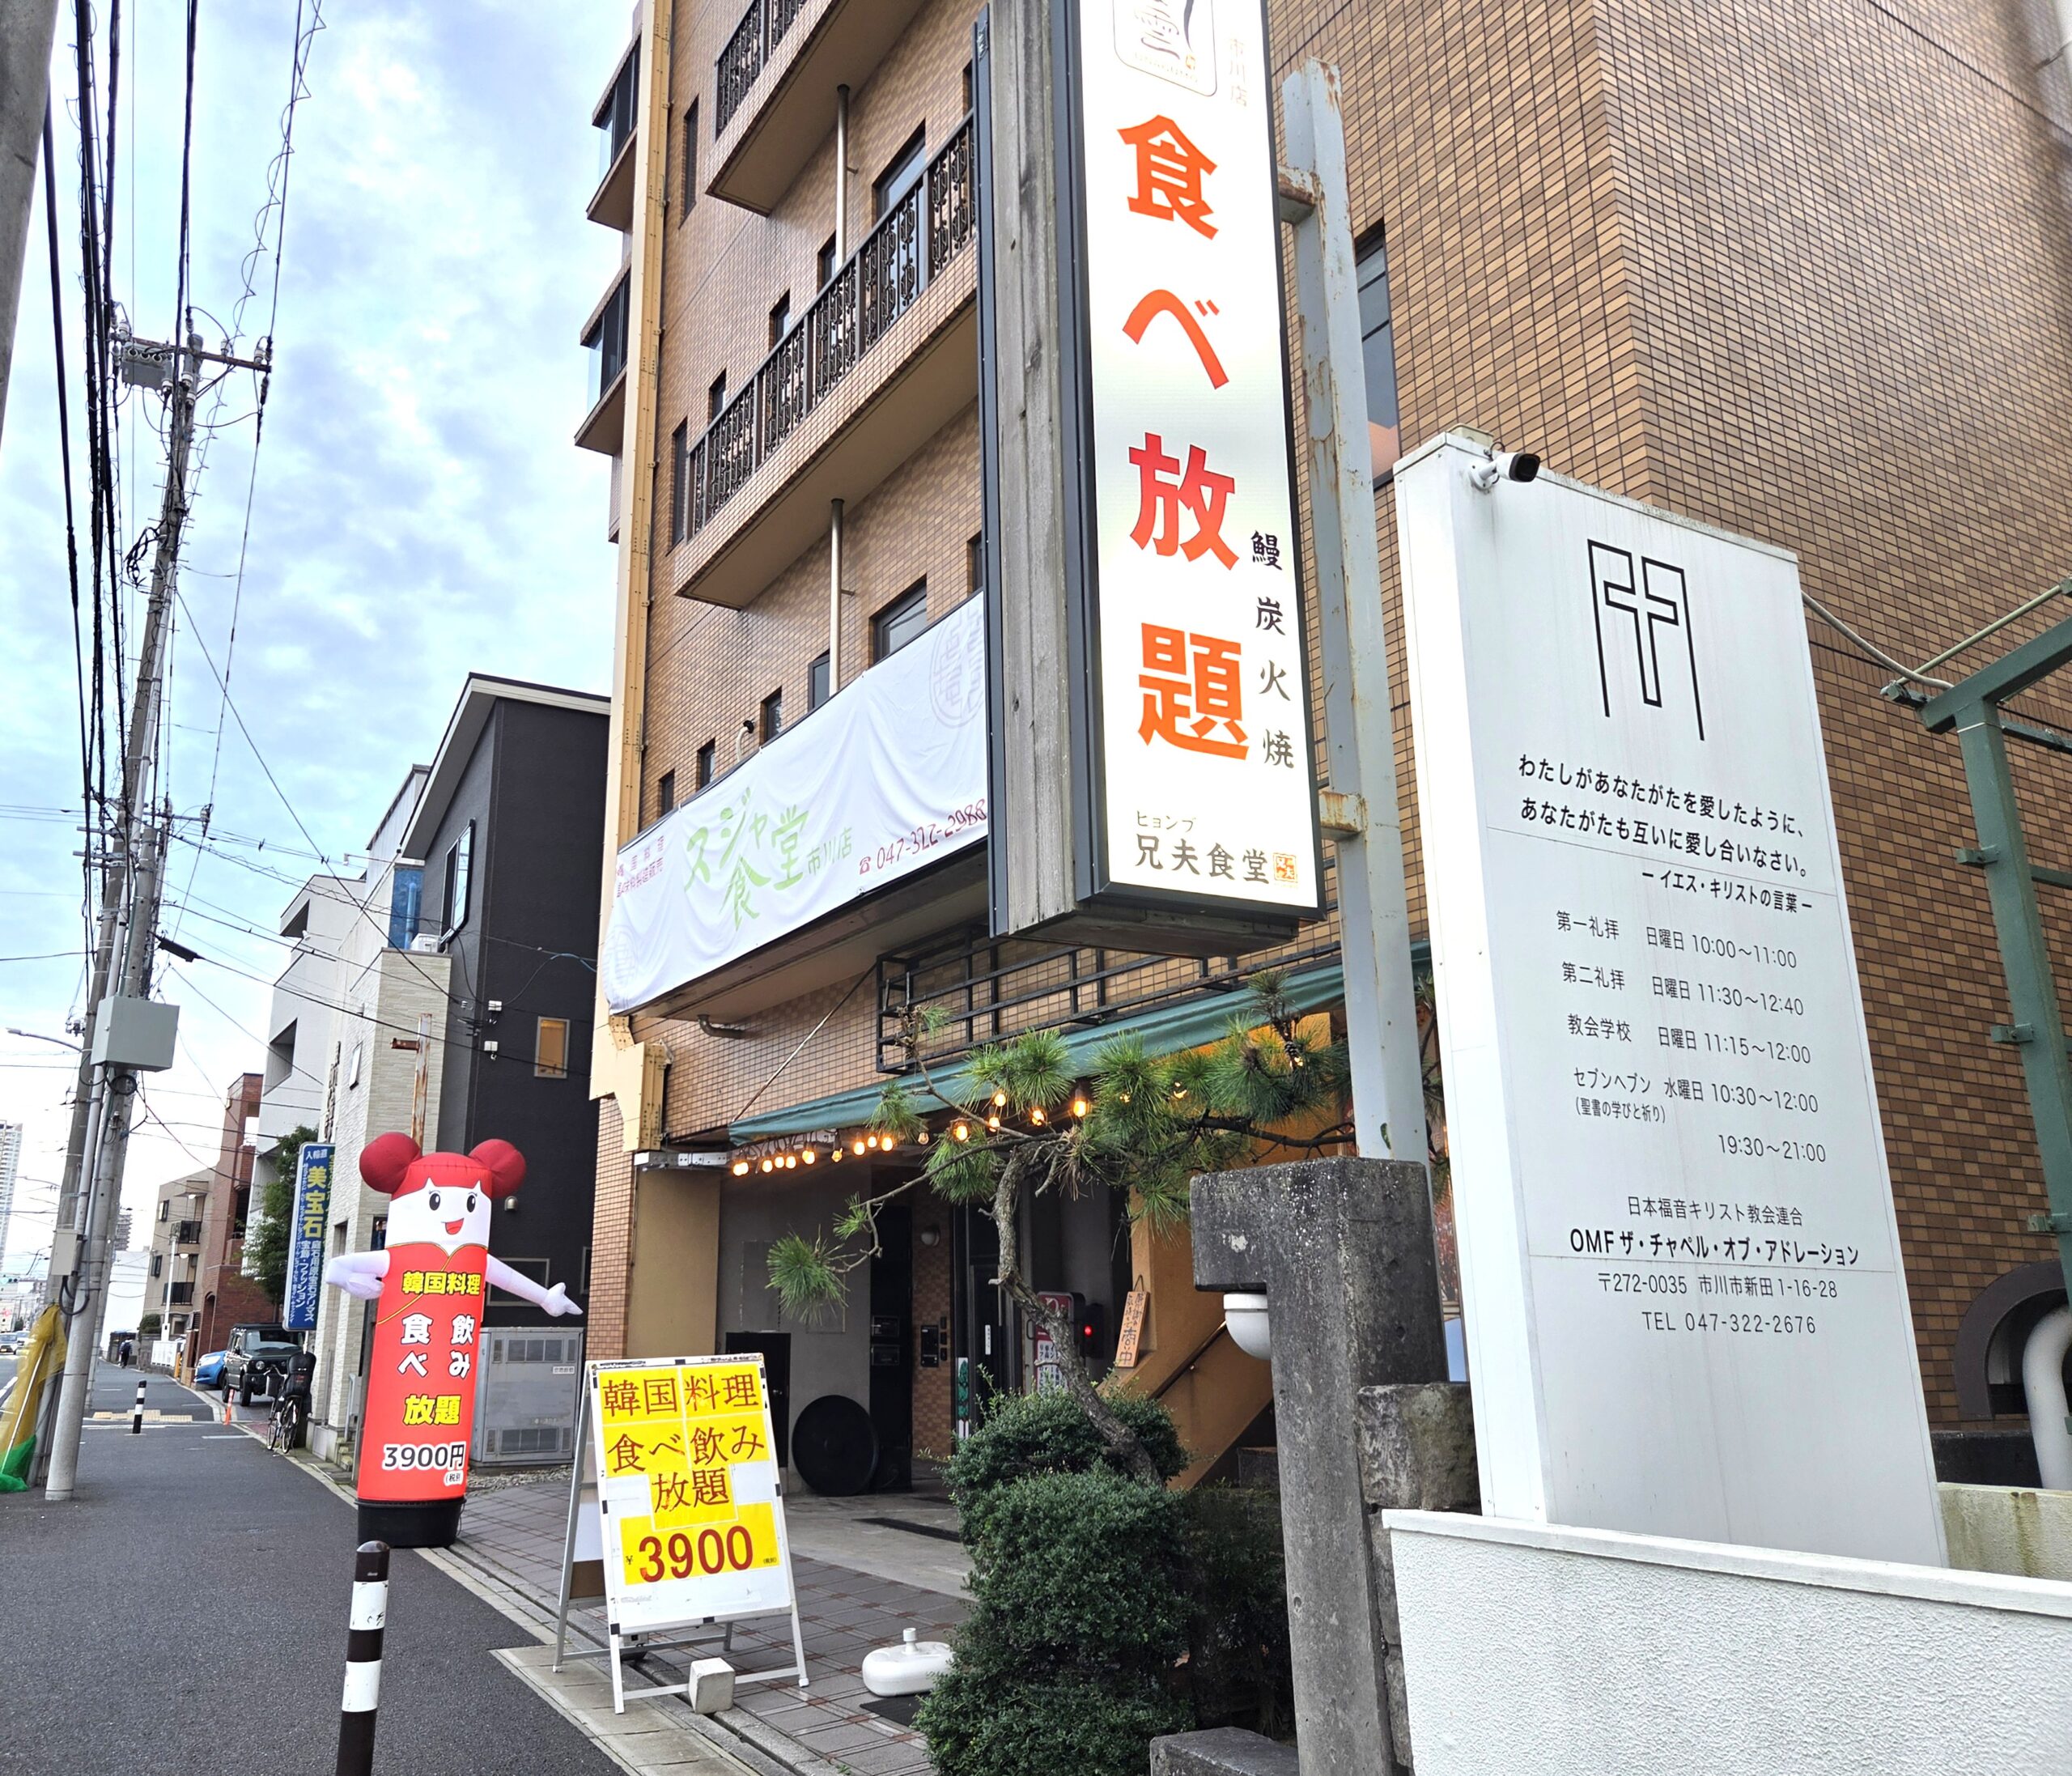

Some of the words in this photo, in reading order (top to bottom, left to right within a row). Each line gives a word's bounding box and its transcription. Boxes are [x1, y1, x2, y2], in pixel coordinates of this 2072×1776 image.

[1117, 114, 1249, 761] 食べ放題
[1250, 529, 1295, 770] 鰻炭火焼
[1518, 754, 1804, 838] わたしがあなたがたを愛したように、
[807, 827, 852, 876] 市川店
[1136, 834, 1270, 884] 兄夫食堂
[1521, 797, 1807, 877] あなたがたも互いに愛し合いなさい。
[1556, 911, 1620, 940] 第一礼拝
[1646, 927, 1684, 952] 日曜日
[1562, 962, 1624, 990] 第二礼拝
[1652, 977, 1690, 1001] 日曜日
[1567, 1013, 1632, 1043] 教会学校
[1658, 1027, 1697, 1050] 日曜日
[1573, 1068, 1651, 1094] セブンヘブン
[1664, 1077, 1704, 1103] 水曜日
[1628, 1196, 1803, 1227] 日本福音キリスト教会連合
[401, 1270, 482, 1295] 韓国料理
[1642, 1311, 1676, 1331] TEL
[1685, 1314, 1815, 1334] 047-322-2676
[397, 1312, 433, 1378] 食べ
[448, 1315, 476, 1379] 飲み
[402, 1394, 462, 1425] 放題
[603, 1374, 759, 1417] 韓国料理
[384, 1444, 465, 1468] 3900円
[607, 1425, 765, 1472] 食べ飲み
[652, 1467, 730, 1513] 放題
